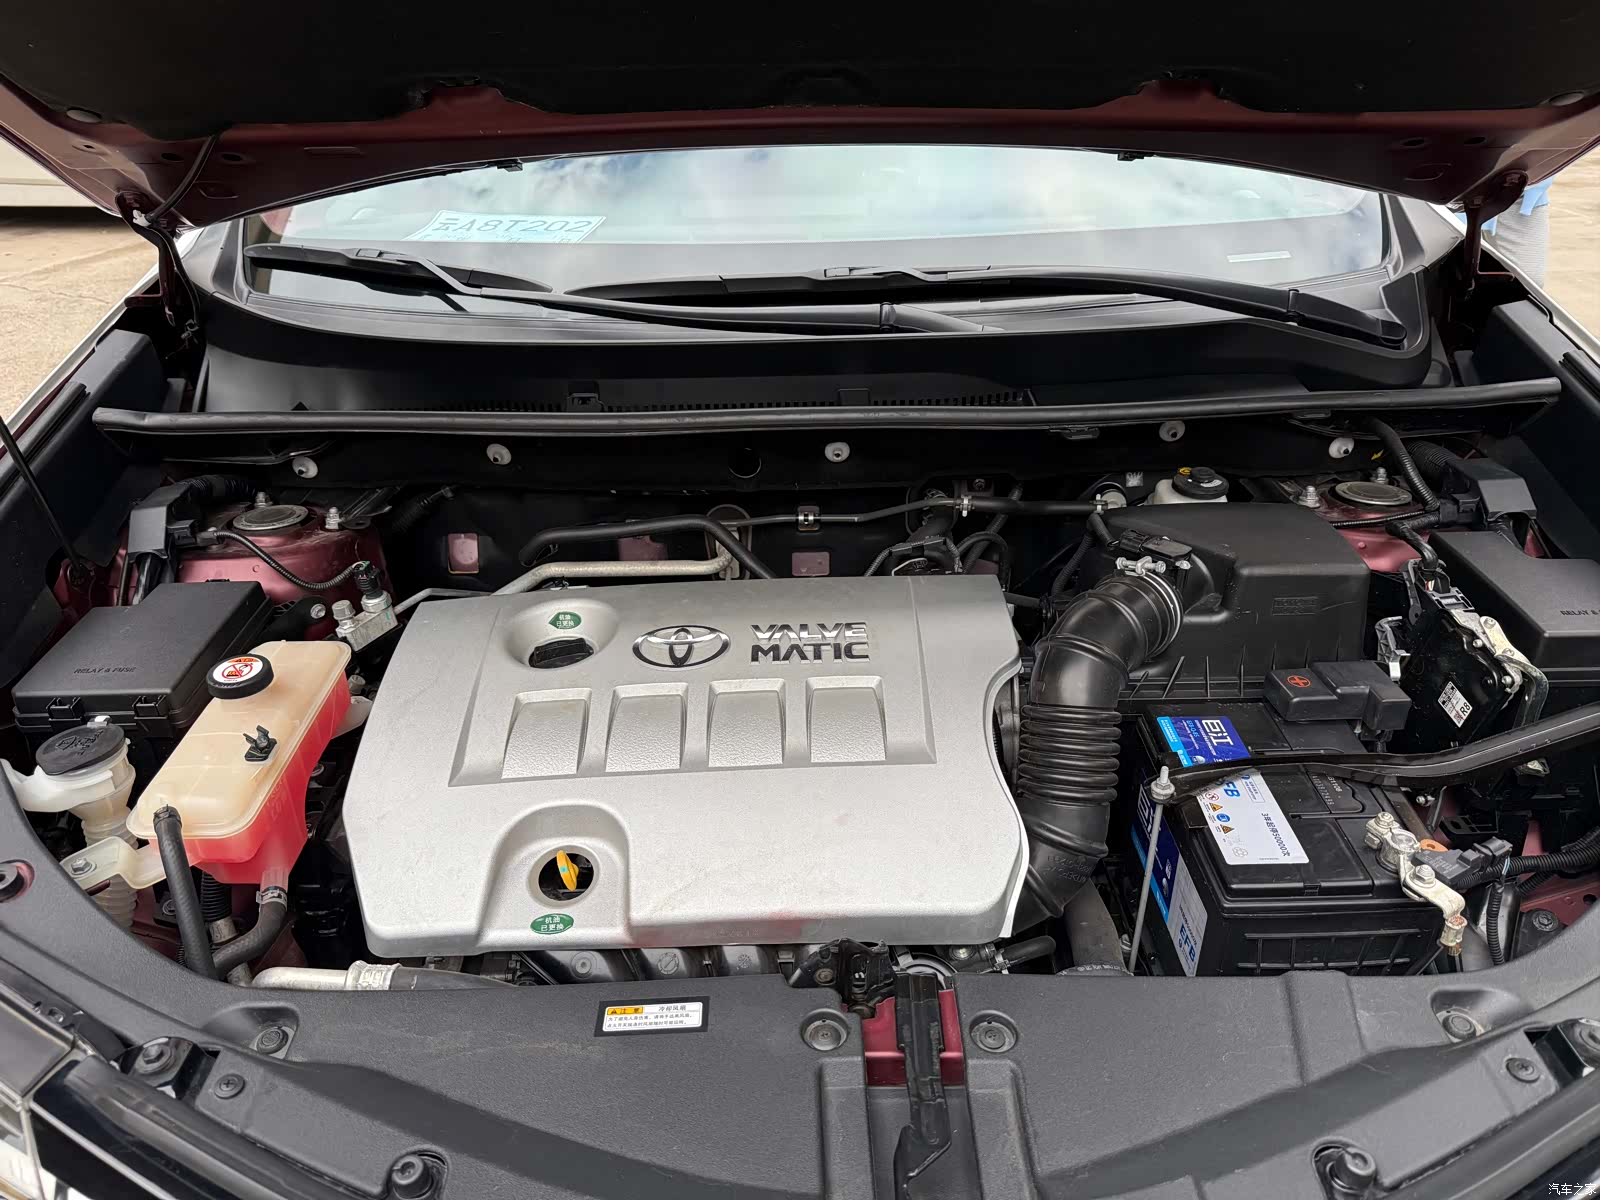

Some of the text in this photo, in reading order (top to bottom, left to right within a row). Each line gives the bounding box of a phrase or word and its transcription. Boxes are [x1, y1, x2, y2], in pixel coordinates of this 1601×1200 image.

[432, 217, 593, 233] 云A8T202
[751, 622, 867, 640] VALVE
[750, 642, 870, 664] MATIC
[1179, 922, 1195, 962] EFB
